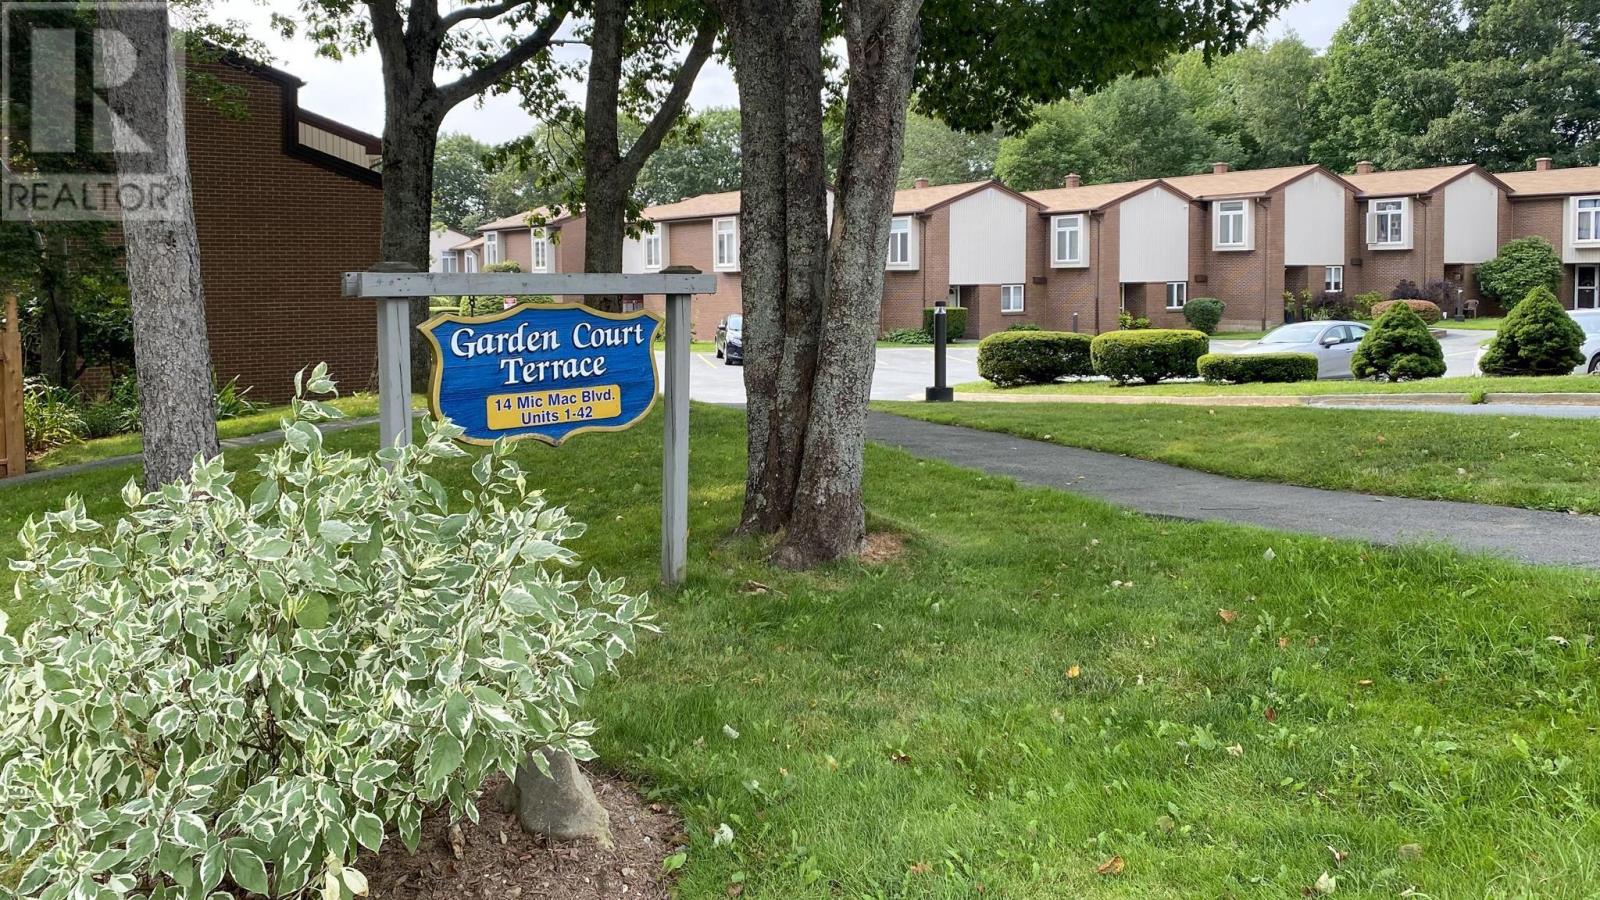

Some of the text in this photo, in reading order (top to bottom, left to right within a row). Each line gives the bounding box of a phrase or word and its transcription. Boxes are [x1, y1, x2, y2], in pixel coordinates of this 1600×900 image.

[451, 322, 645, 358] Garden Court
[500, 355, 607, 385] Terrace
[495, 389, 616, 411] 14 Mic Mac Blvd.
[521, 406, 593, 425] Units 1-42
